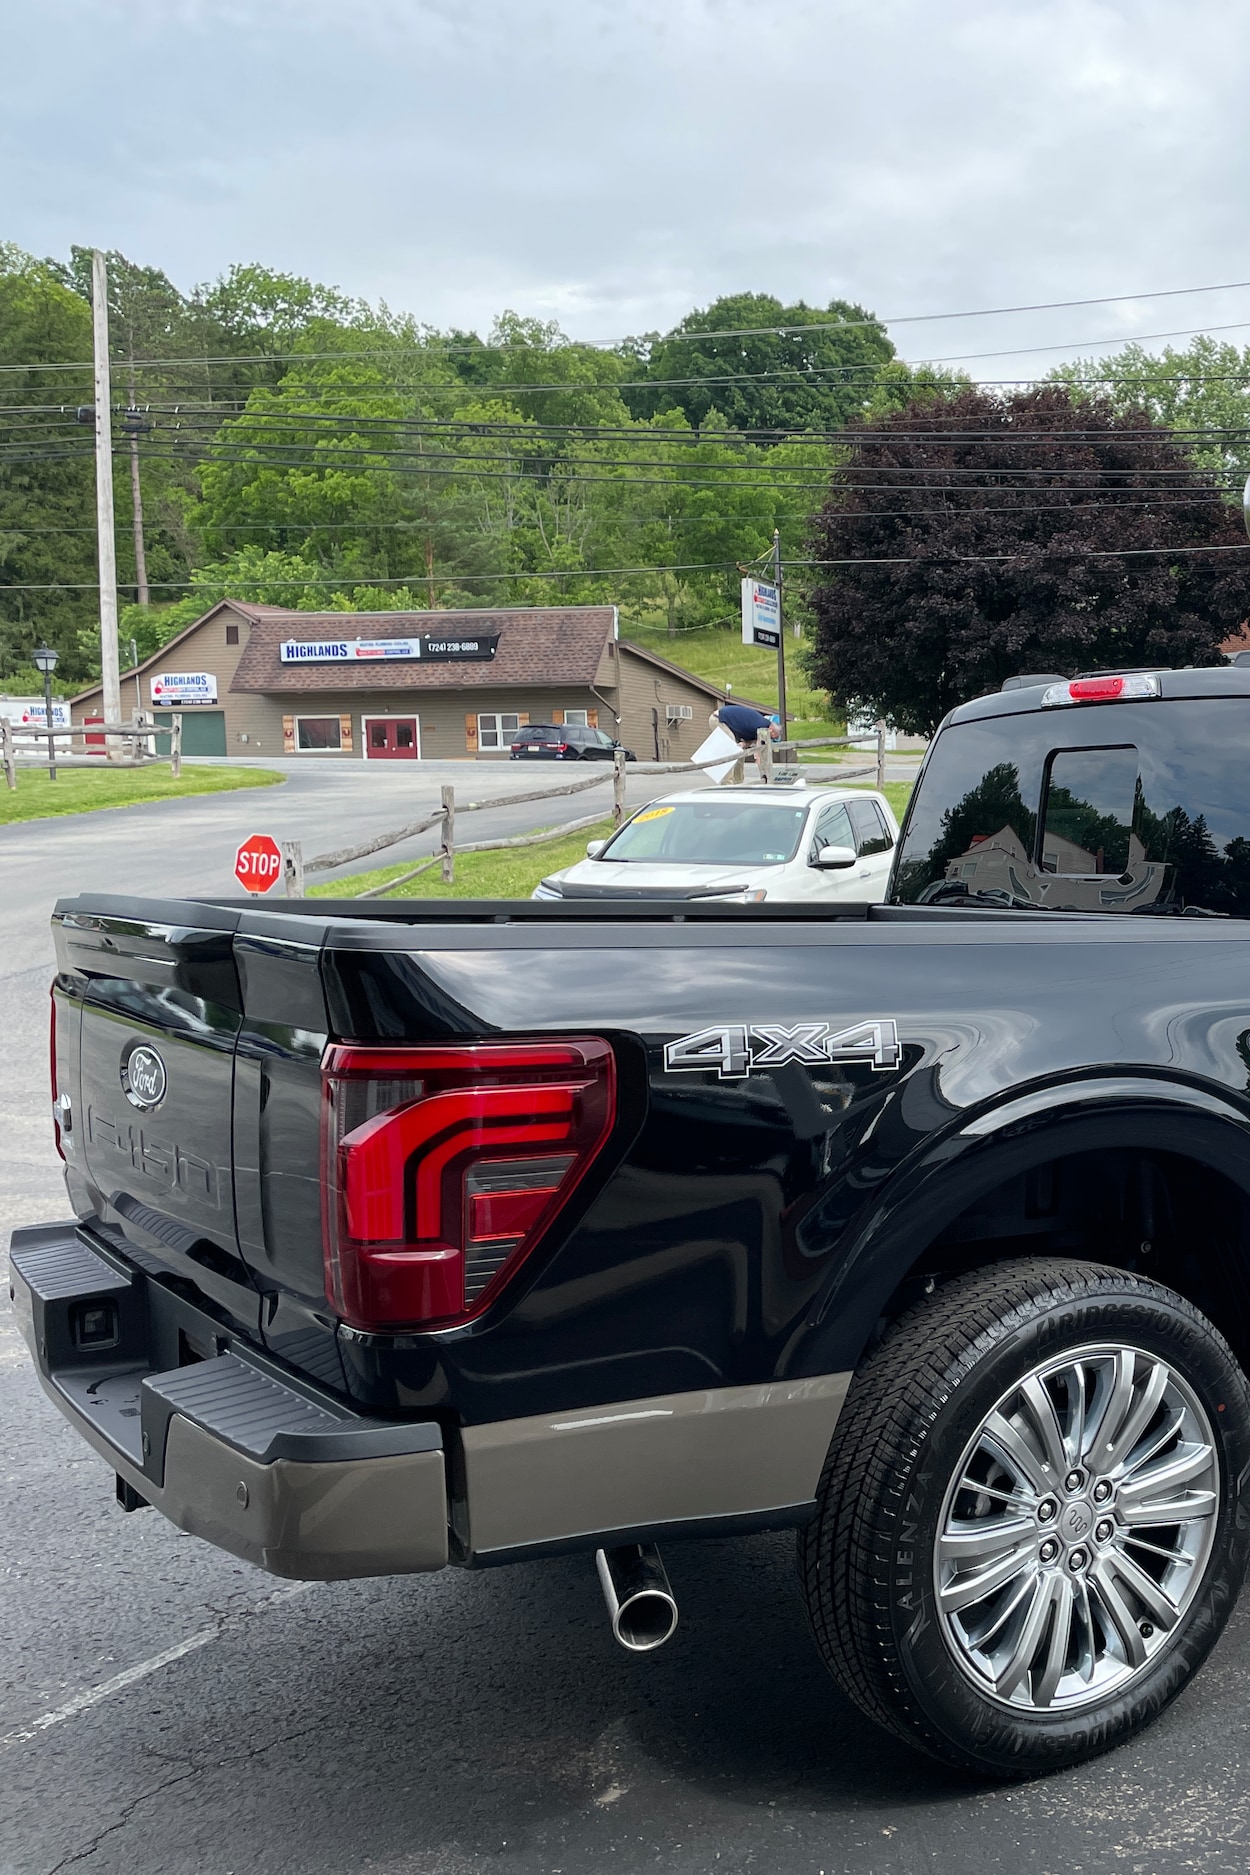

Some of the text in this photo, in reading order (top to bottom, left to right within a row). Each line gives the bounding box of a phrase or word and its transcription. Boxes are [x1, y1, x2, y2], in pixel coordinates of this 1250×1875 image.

[286, 644, 348, 659] HIGHLANDS
[164, 675, 207, 687] HIGHLANDS
[238, 851, 280, 876] STOP
[133, 1053, 158, 1096] Ford
[1035, 1302, 1200, 1349] BRIDGESTONE
[895, 1471, 935, 1612] ALENZA
